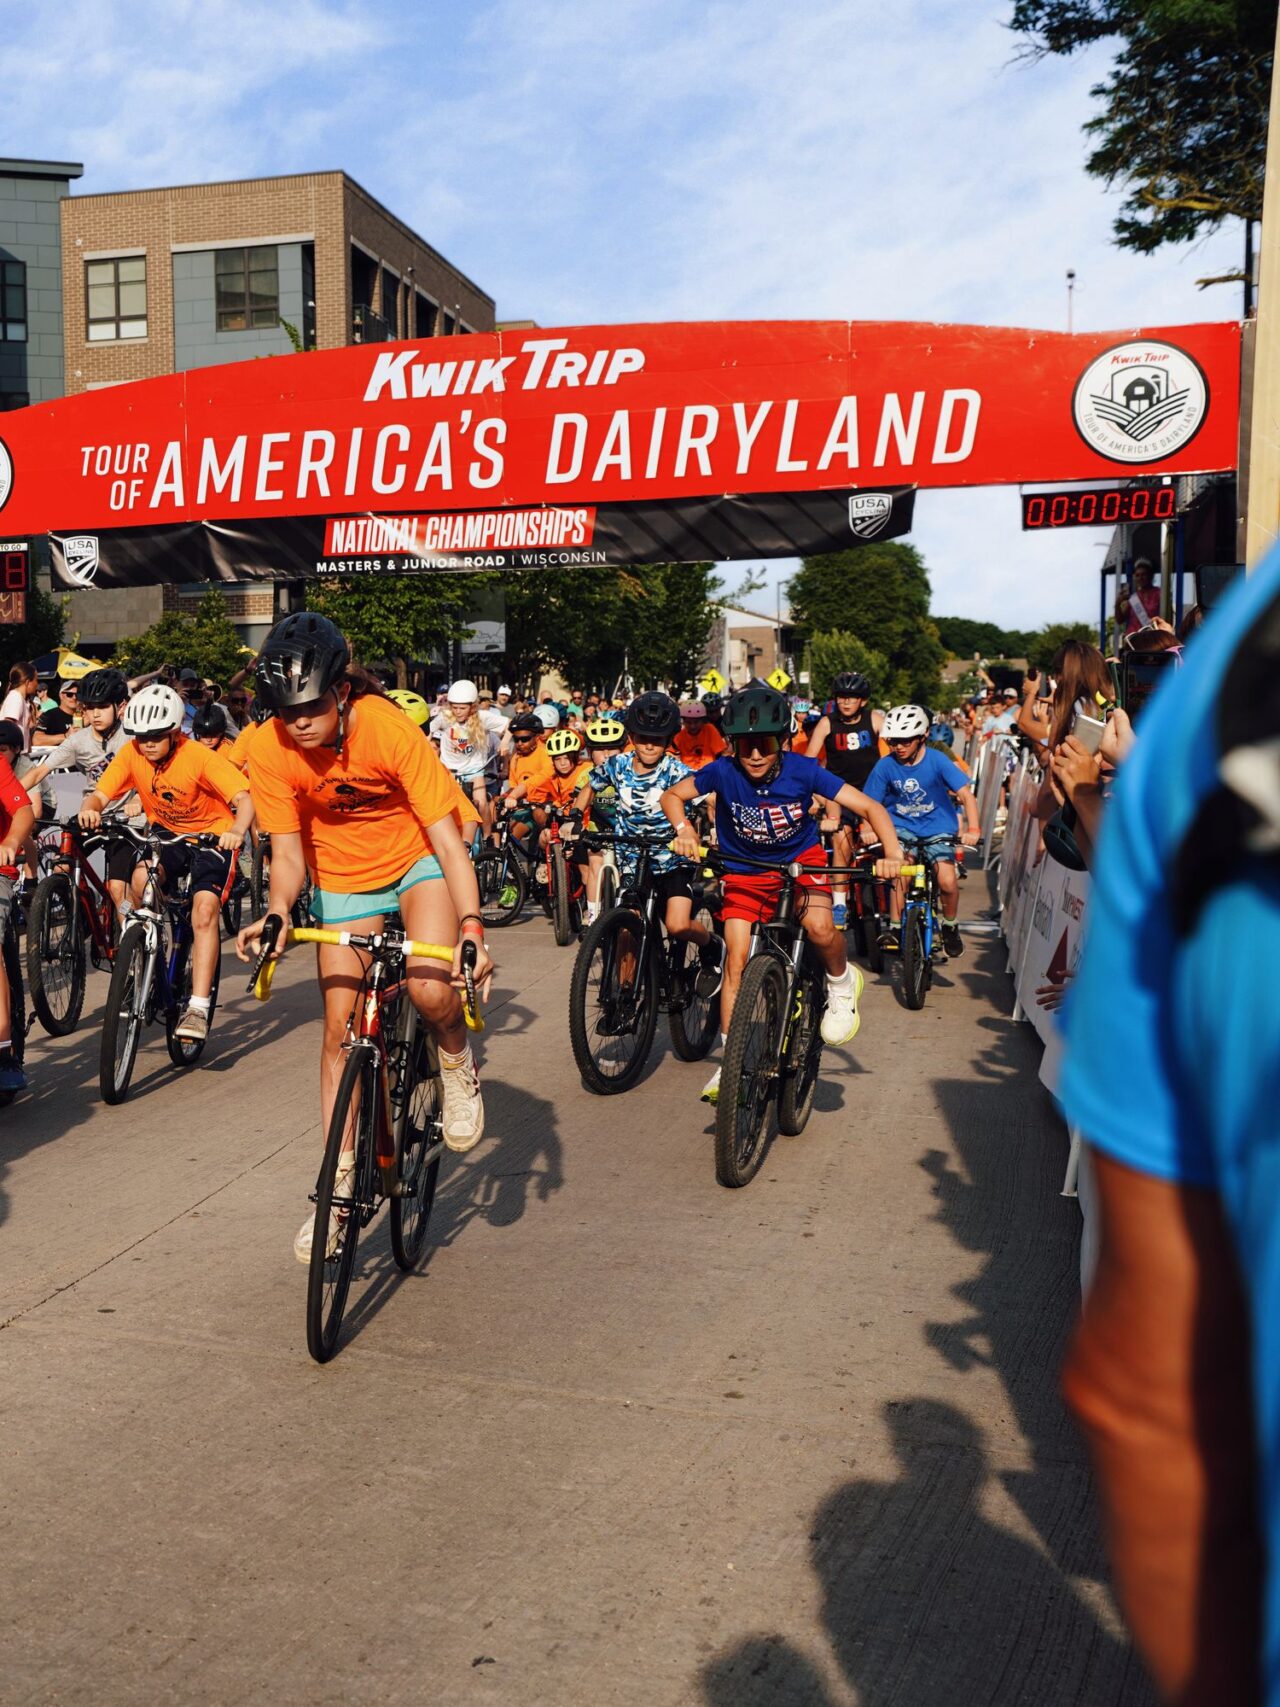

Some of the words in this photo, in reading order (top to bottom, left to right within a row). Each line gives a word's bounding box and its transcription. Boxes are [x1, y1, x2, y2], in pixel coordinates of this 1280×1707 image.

[363, 350, 517, 402] KWIK
[521, 339, 645, 390] TRIP
[1084, 413, 1099, 430] TOUR
[1097, 432, 1108, 442] OF
[1109, 440, 1159, 454] AMERICA'S
[1160, 406, 1197, 448] DAIRYLAND
[81, 443, 150, 476] TOUR
[149, 410, 507, 508] AMERICA'S
[545, 388, 981, 485] DAIRYLAND
[110, 480, 143, 510] OF
[855, 499, 885, 509] USA
[1026, 489, 1174, 526] 00:00:00
[68, 540, 93, 550] USA
[331, 518, 418, 553] NATIONAL
[425, 510, 587, 550] CHAMPIONSHIPS
[316, 560, 381, 572] MASTERS
[387, 560, 396, 570] &
[402, 557, 458, 569] JUNIOR
[465, 555, 506, 567] ROAD
[521, 551, 606, 564] WISCONSIN
